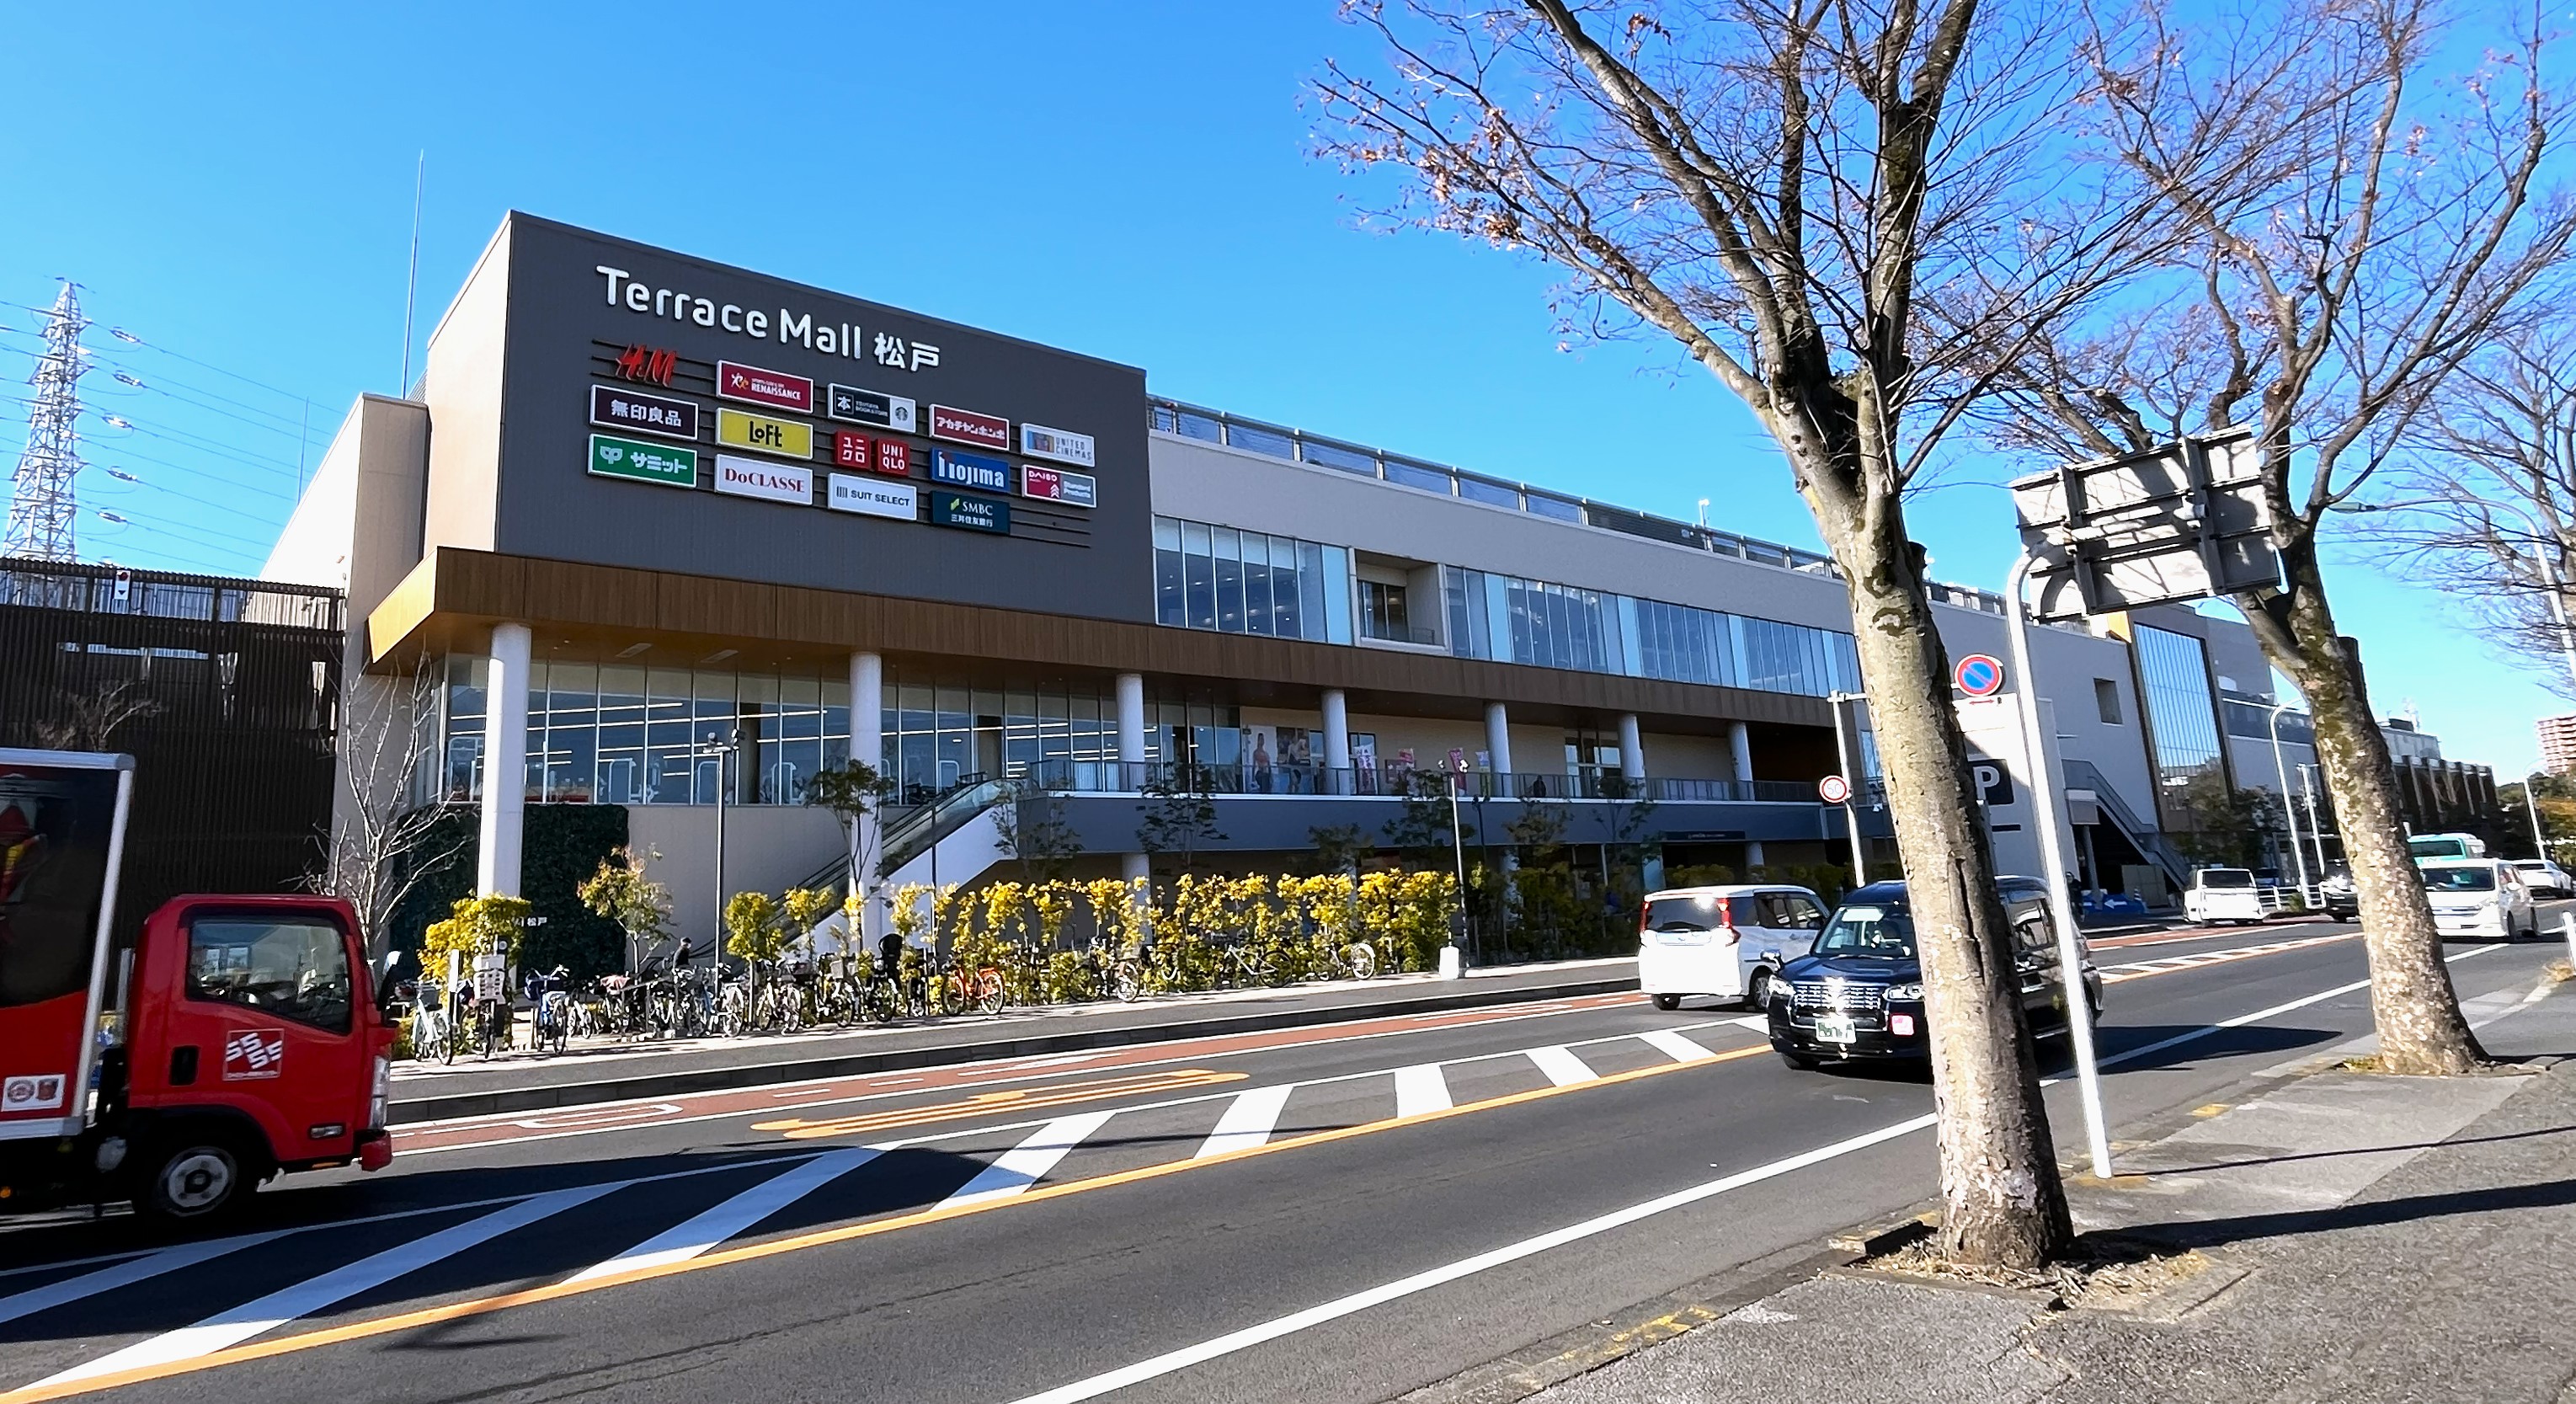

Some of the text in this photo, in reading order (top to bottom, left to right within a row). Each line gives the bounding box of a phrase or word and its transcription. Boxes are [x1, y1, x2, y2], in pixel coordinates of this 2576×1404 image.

[596, 265, 940, 371] Terrace Mall 松戸
[751, 383, 801, 401] RENAISSANCE
[611, 398, 682, 428] 無印良品
[883, 443, 903, 457] UNI
[1056, 436, 1085, 451] UNITED
[1056, 446, 1091, 461] CINEMAS
[630, 451, 687, 474] サミット
[883, 456, 905, 470] QLO
[724, 468, 805, 493] DoCLASSE
[851, 490, 910, 506] SUIT SELECT
[963, 501, 993, 515] SMBC
[1827, 782, 1843, 795] 50
[1973, 765, 2000, 800] P
